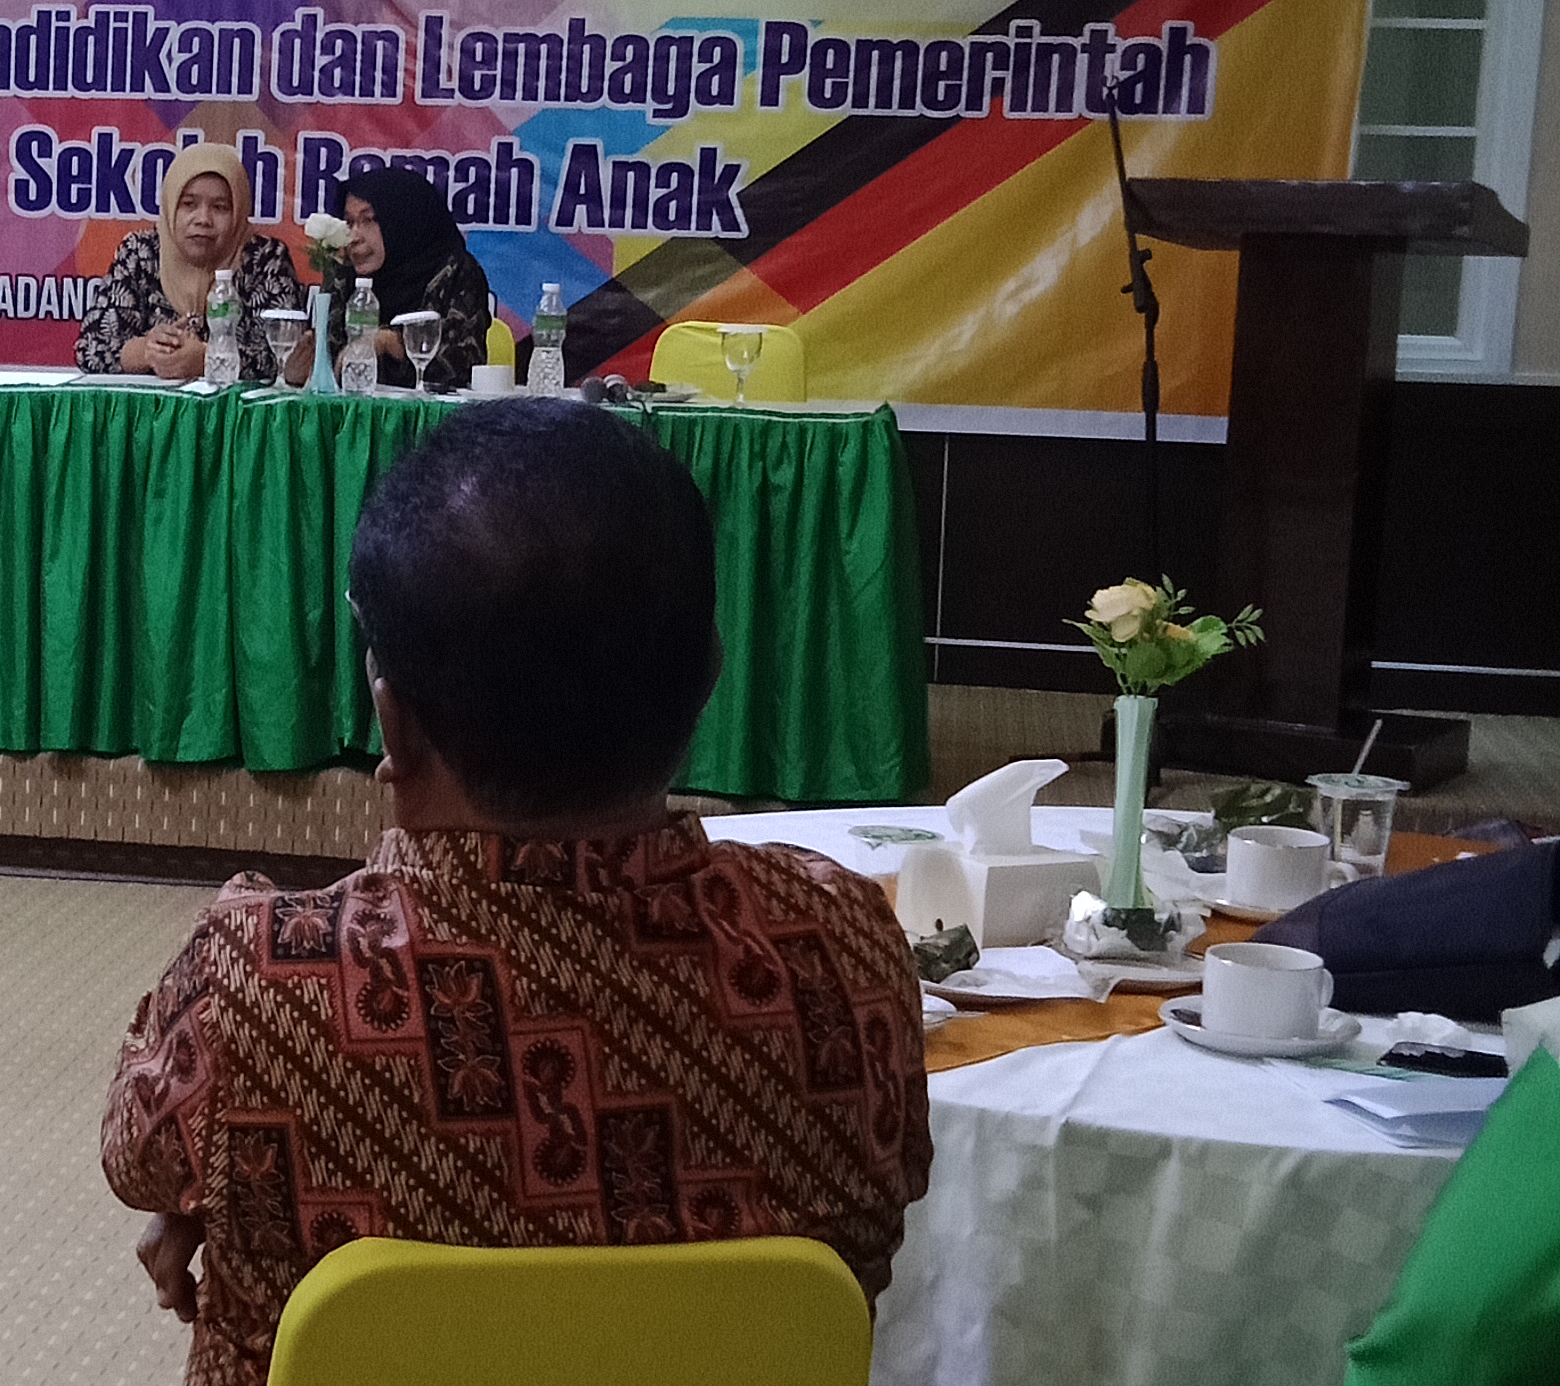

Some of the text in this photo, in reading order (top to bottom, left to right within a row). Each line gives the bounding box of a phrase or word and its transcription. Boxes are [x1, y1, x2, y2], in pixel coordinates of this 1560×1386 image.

[276, 12, 404, 100] dan
[420, 15, 739, 119] Lembaga
[759, 19, 1213, 117] Pemerintah
[15, 129, 282, 219] Sekoh
[556, 143, 744, 233] Anak
